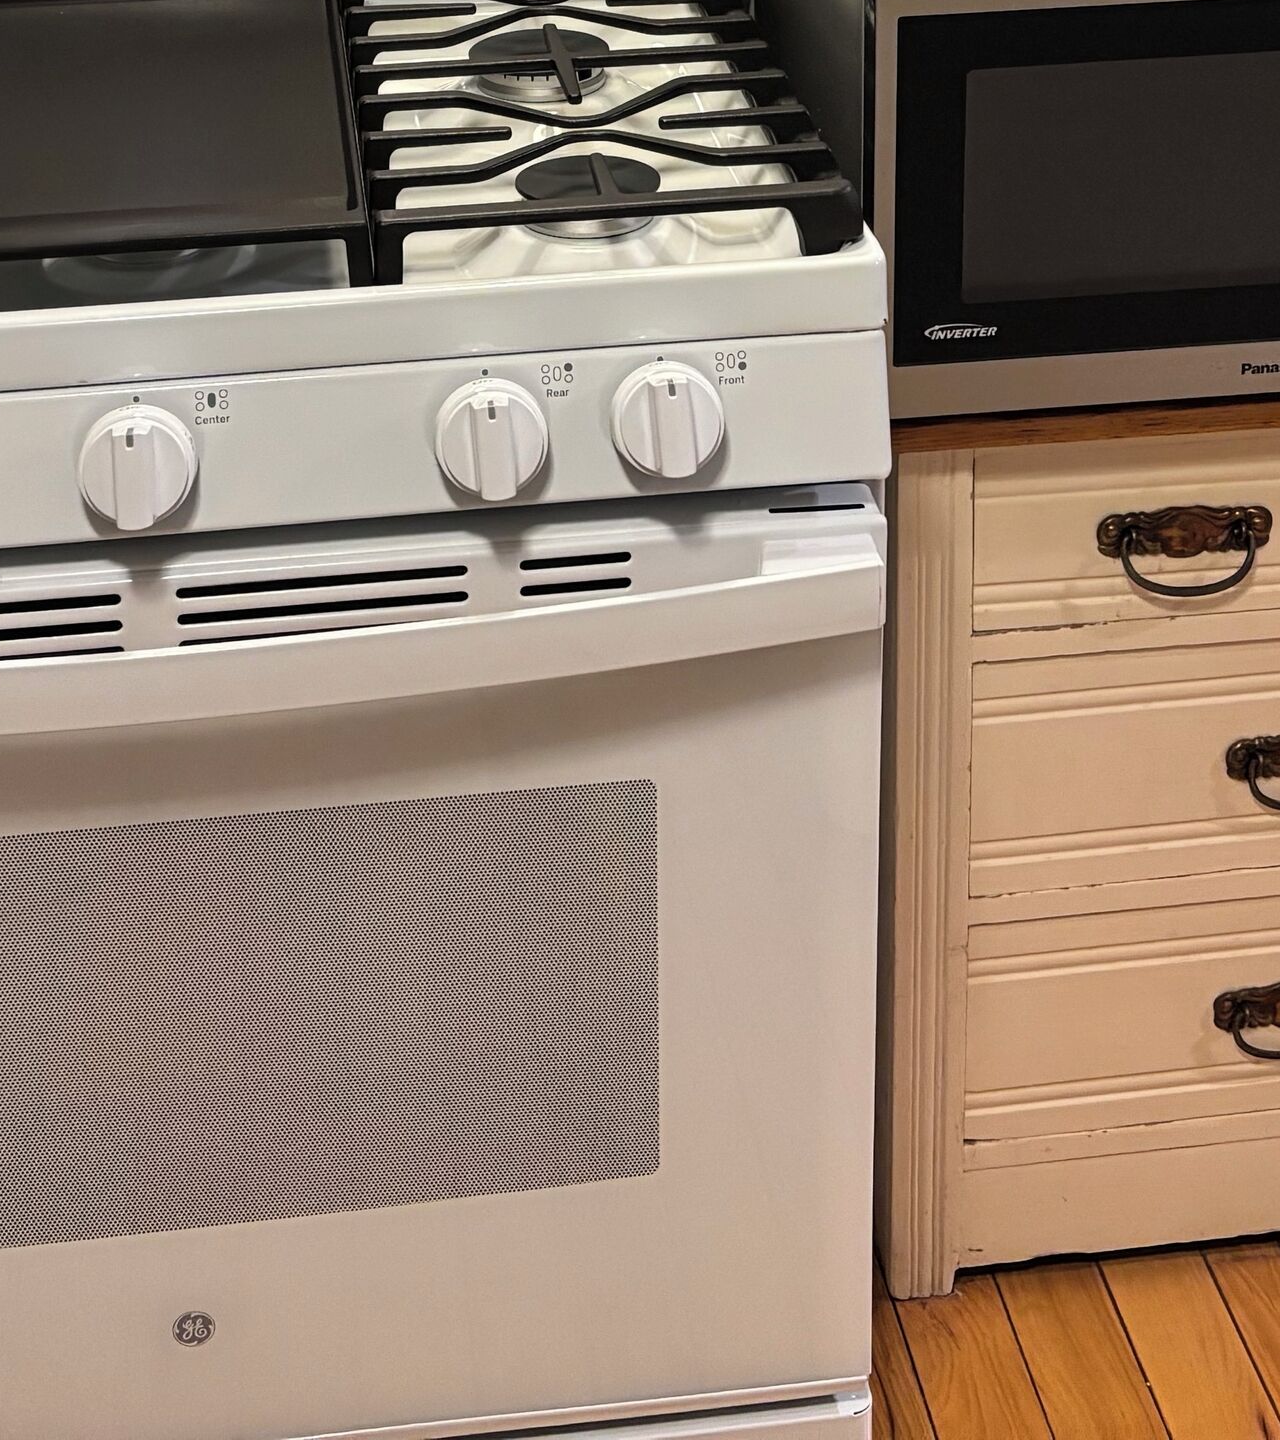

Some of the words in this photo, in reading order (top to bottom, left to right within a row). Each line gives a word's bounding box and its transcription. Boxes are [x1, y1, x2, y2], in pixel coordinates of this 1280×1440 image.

[930, 325, 998, 340] INVERTER
[718, 376, 745, 385] Front
[546, 389, 569, 398] Rear
[195, 415, 230, 425] Center
